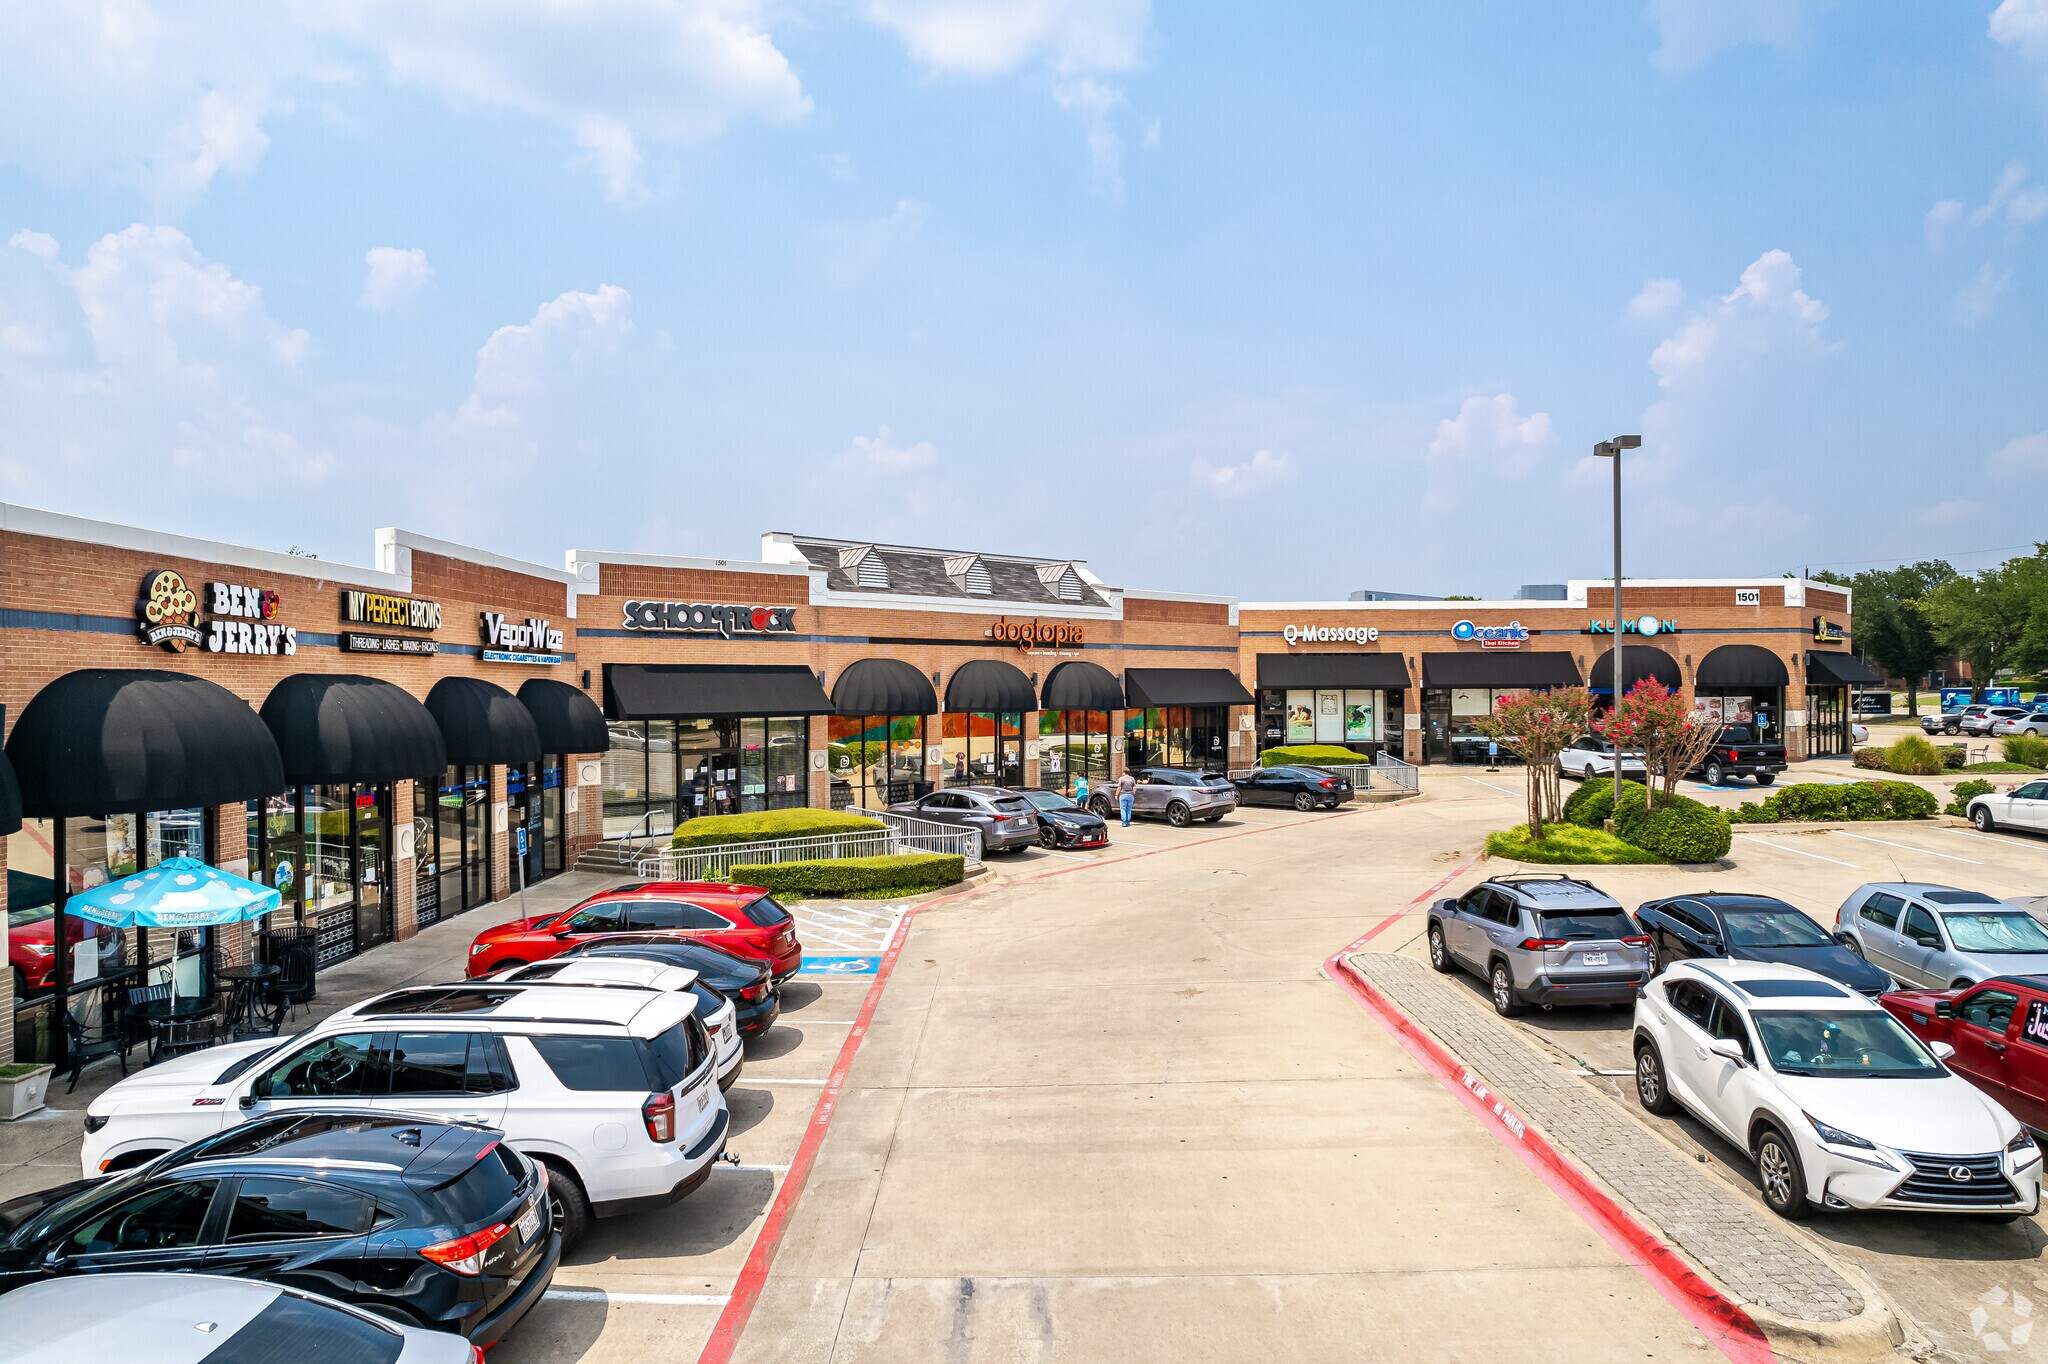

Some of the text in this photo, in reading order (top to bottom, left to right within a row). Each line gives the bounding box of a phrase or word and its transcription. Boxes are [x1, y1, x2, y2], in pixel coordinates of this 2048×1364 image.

[213, 581, 261, 618] BEN
[1737, 592, 1759, 602] 1501
[349, 590, 441, 629] MY PERFECT BROWS
[993, 615, 1085, 652] dogtopia
[1283, 624, 1379, 645] Q Massage
[1452, 620, 1529, 640] Oceanic
[1590, 615, 1676, 637] KUMON
[208, 620, 297, 656] JERRY'S
[352, 636, 439, 652] THREADING LASHES WAXING FACIALS
[484, 651, 512, 661] ELECTRONIC
[512, 654, 537, 663] CIGARETTES
[1462, 1071, 1526, 1139] FIRE LANE NO PARKING
[485, 1251, 505, 1267] HR-V
